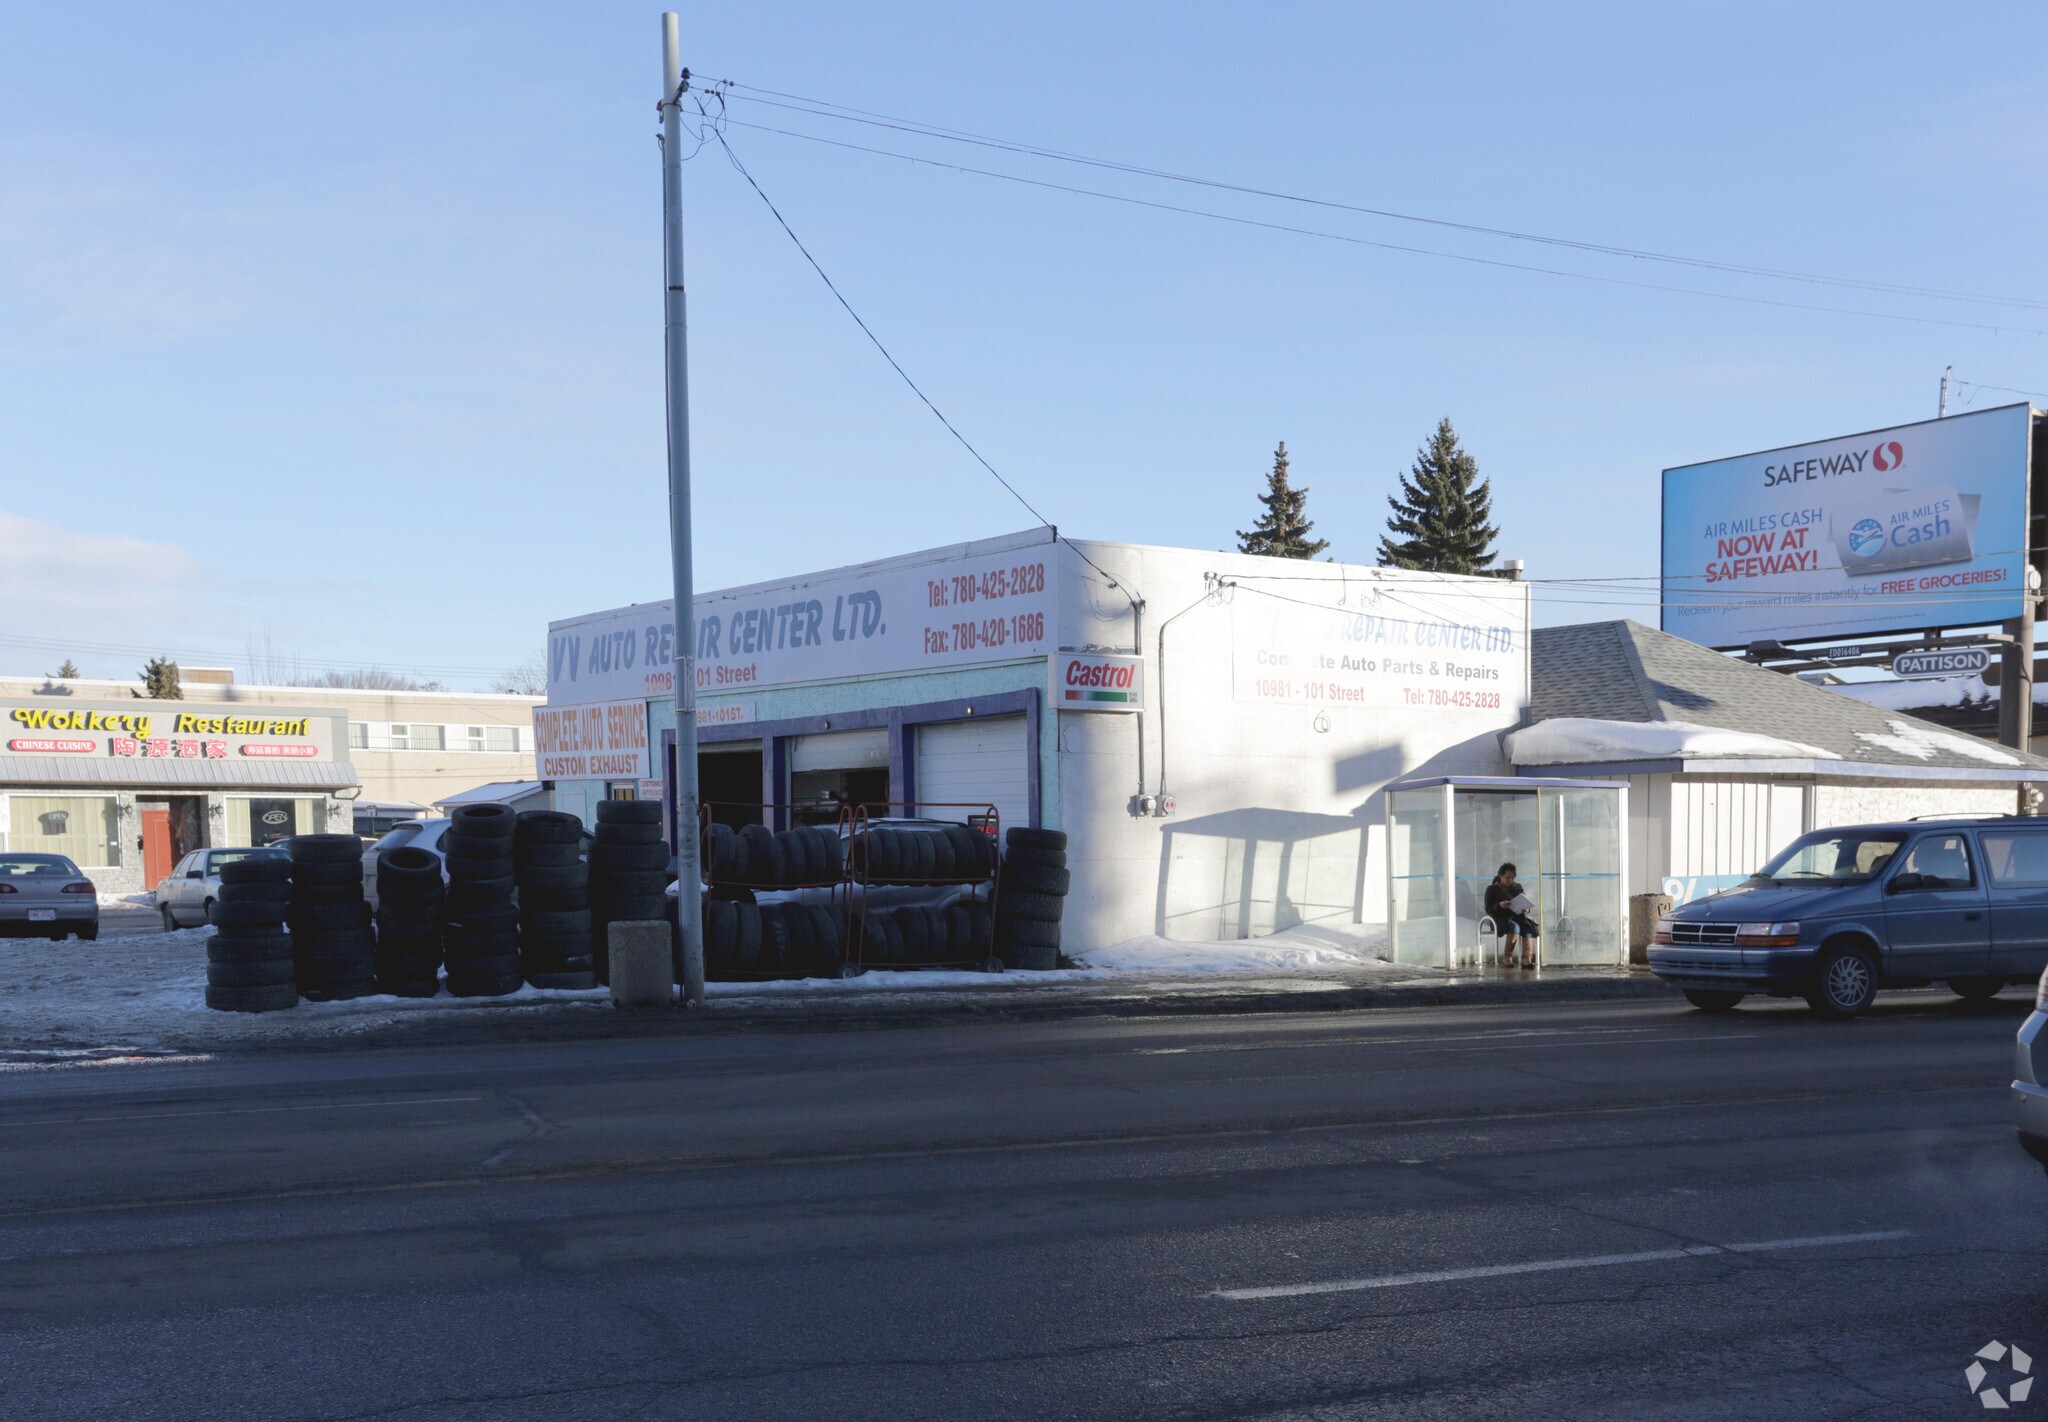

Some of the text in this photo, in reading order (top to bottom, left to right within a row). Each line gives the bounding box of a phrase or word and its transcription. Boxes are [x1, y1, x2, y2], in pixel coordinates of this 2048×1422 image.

[1764, 450, 1869, 488] SAFEWAY
[1704, 507, 1823, 540] AIR MILES CASH
[1890, 500, 1950, 525] AIR MILES
[1717, 527, 1809, 560] NOW AT
[1891, 514, 1950, 548] Cash
[1705, 549, 1818, 583] SAFEWAY!
[928, 562, 1045, 608] Tel: 780-425-2828
[1677, 568, 2007, 617] Redeem your reward miles instantly for FREE GROCERIES!
[553, 589, 887, 682] VV AUTO REIR CENTER LTD.
[924, 612, 1044, 655] Fax: 780-420-1686
[1340, 613, 1410, 648] REPAIR
[1415, 620, 1482, 652] CENTER
[1485, 625, 1515, 654] LTD.
[696, 666, 711, 687] 01
[716, 662, 757, 685] Street
[1065, 659, 1136, 689] Castrol
[1257, 649, 1500, 681] Comte Auto Parts & Repairs
[1901, 653, 1982, 672] PATTISON
[1255, 679, 1292, 698] 10981
[1304, 682, 1324, 700] 101
[1329, 684, 1365, 702] Street
[1404, 688, 1501, 709] Tel: 780-425-2828
[14, 708, 311, 740] Wokkery Restaurant
[535, 703, 646, 753] COMPLETE AUTO SERVICE
[16, 740, 92, 751] CHINESE CUISINE
[544, 753, 639, 776] CUSTOM EXHAUST
